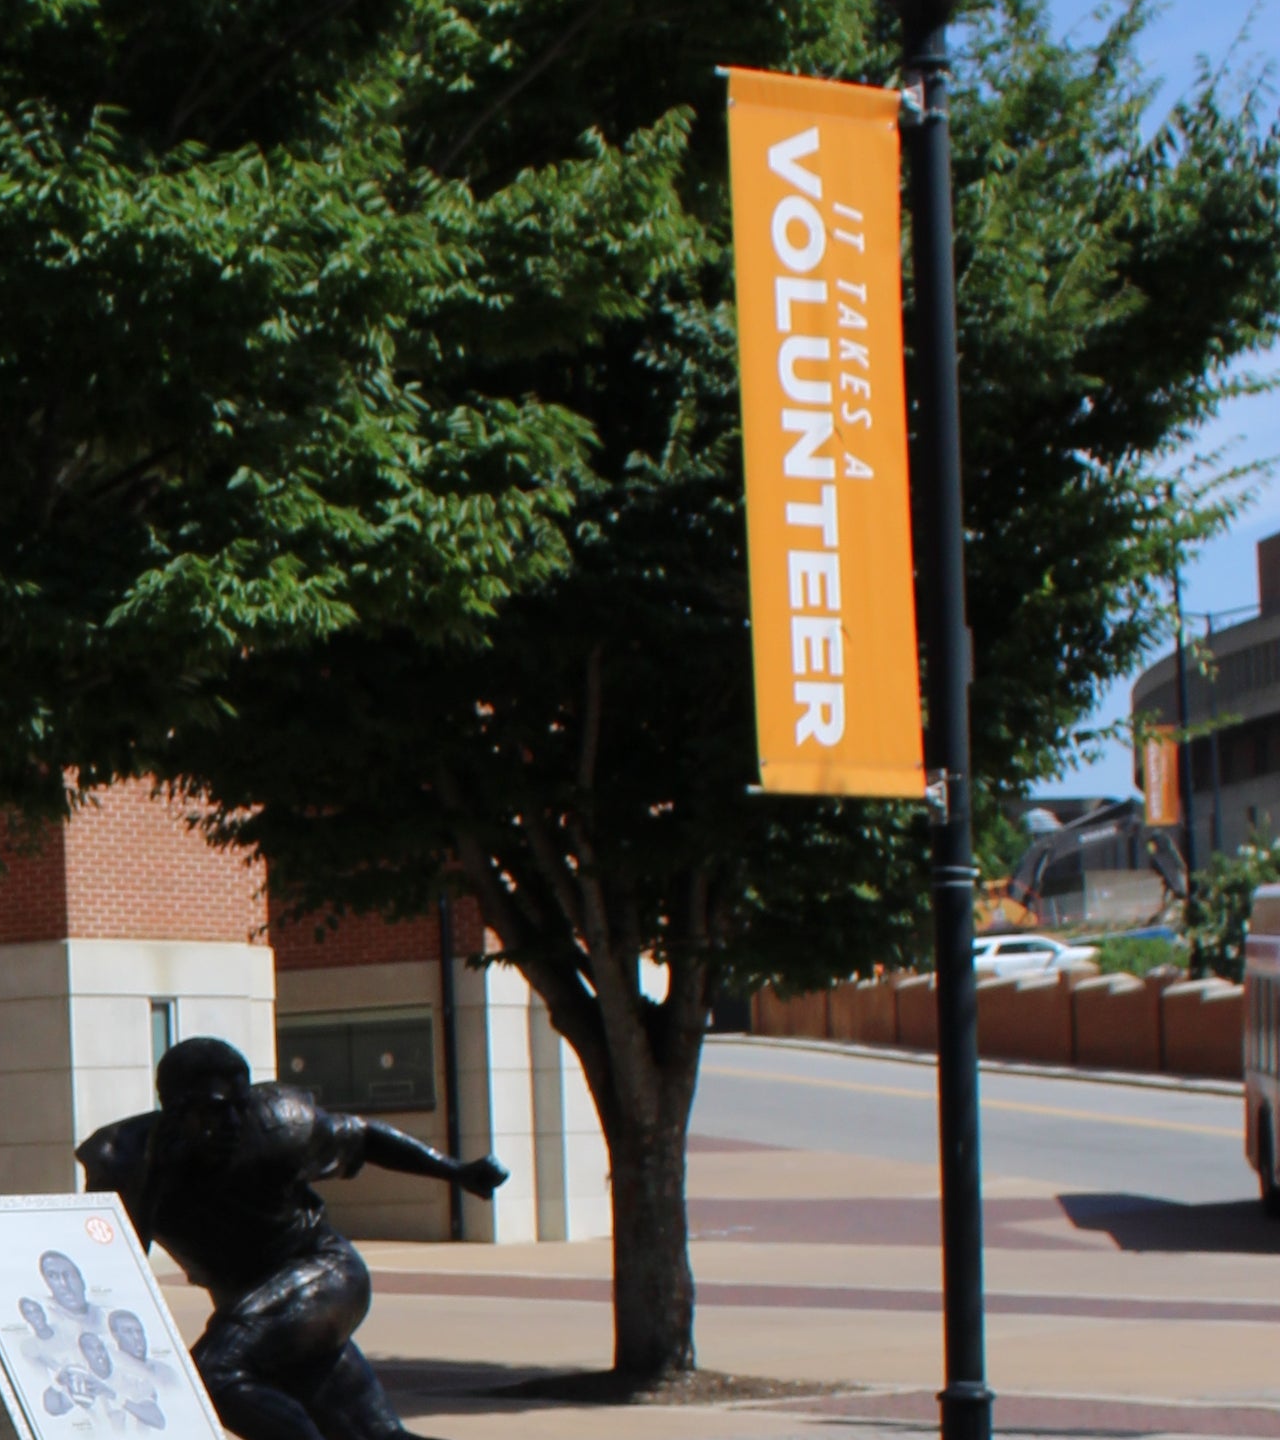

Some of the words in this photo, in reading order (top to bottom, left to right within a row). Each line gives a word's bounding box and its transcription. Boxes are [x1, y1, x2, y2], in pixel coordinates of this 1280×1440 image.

[832, 203, 865, 255] IT
[837, 278, 872, 431] TAKES
[766, 127, 846, 748] VOLUNTEER
[844, 453, 874, 480] A
